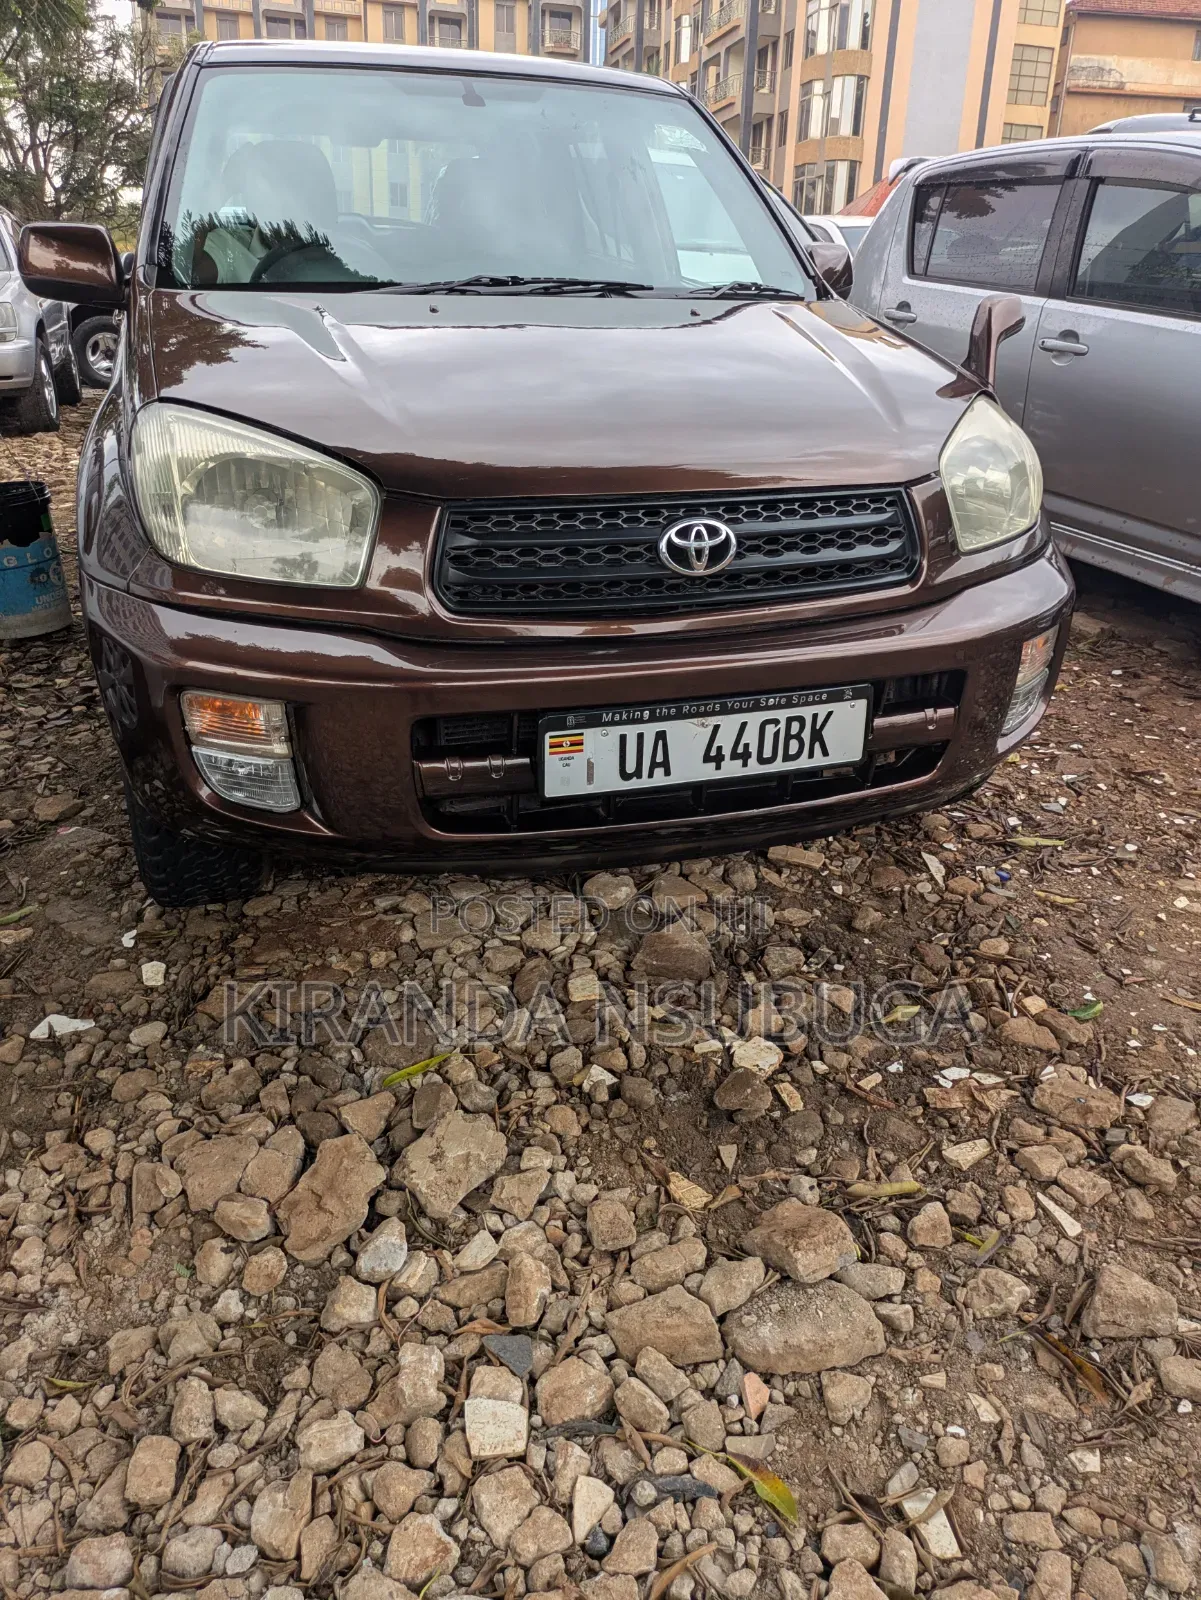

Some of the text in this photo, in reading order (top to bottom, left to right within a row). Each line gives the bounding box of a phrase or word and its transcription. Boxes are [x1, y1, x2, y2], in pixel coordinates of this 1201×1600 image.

[602, 711, 649, 722] Making
[656, 706, 676, 716] the
[682, 703, 720, 714] Roads
[727, 699, 754, 709] Your
[759, 695, 787, 706] Safe
[793, 692, 828, 704] Space
[619, 730, 672, 781] UA
